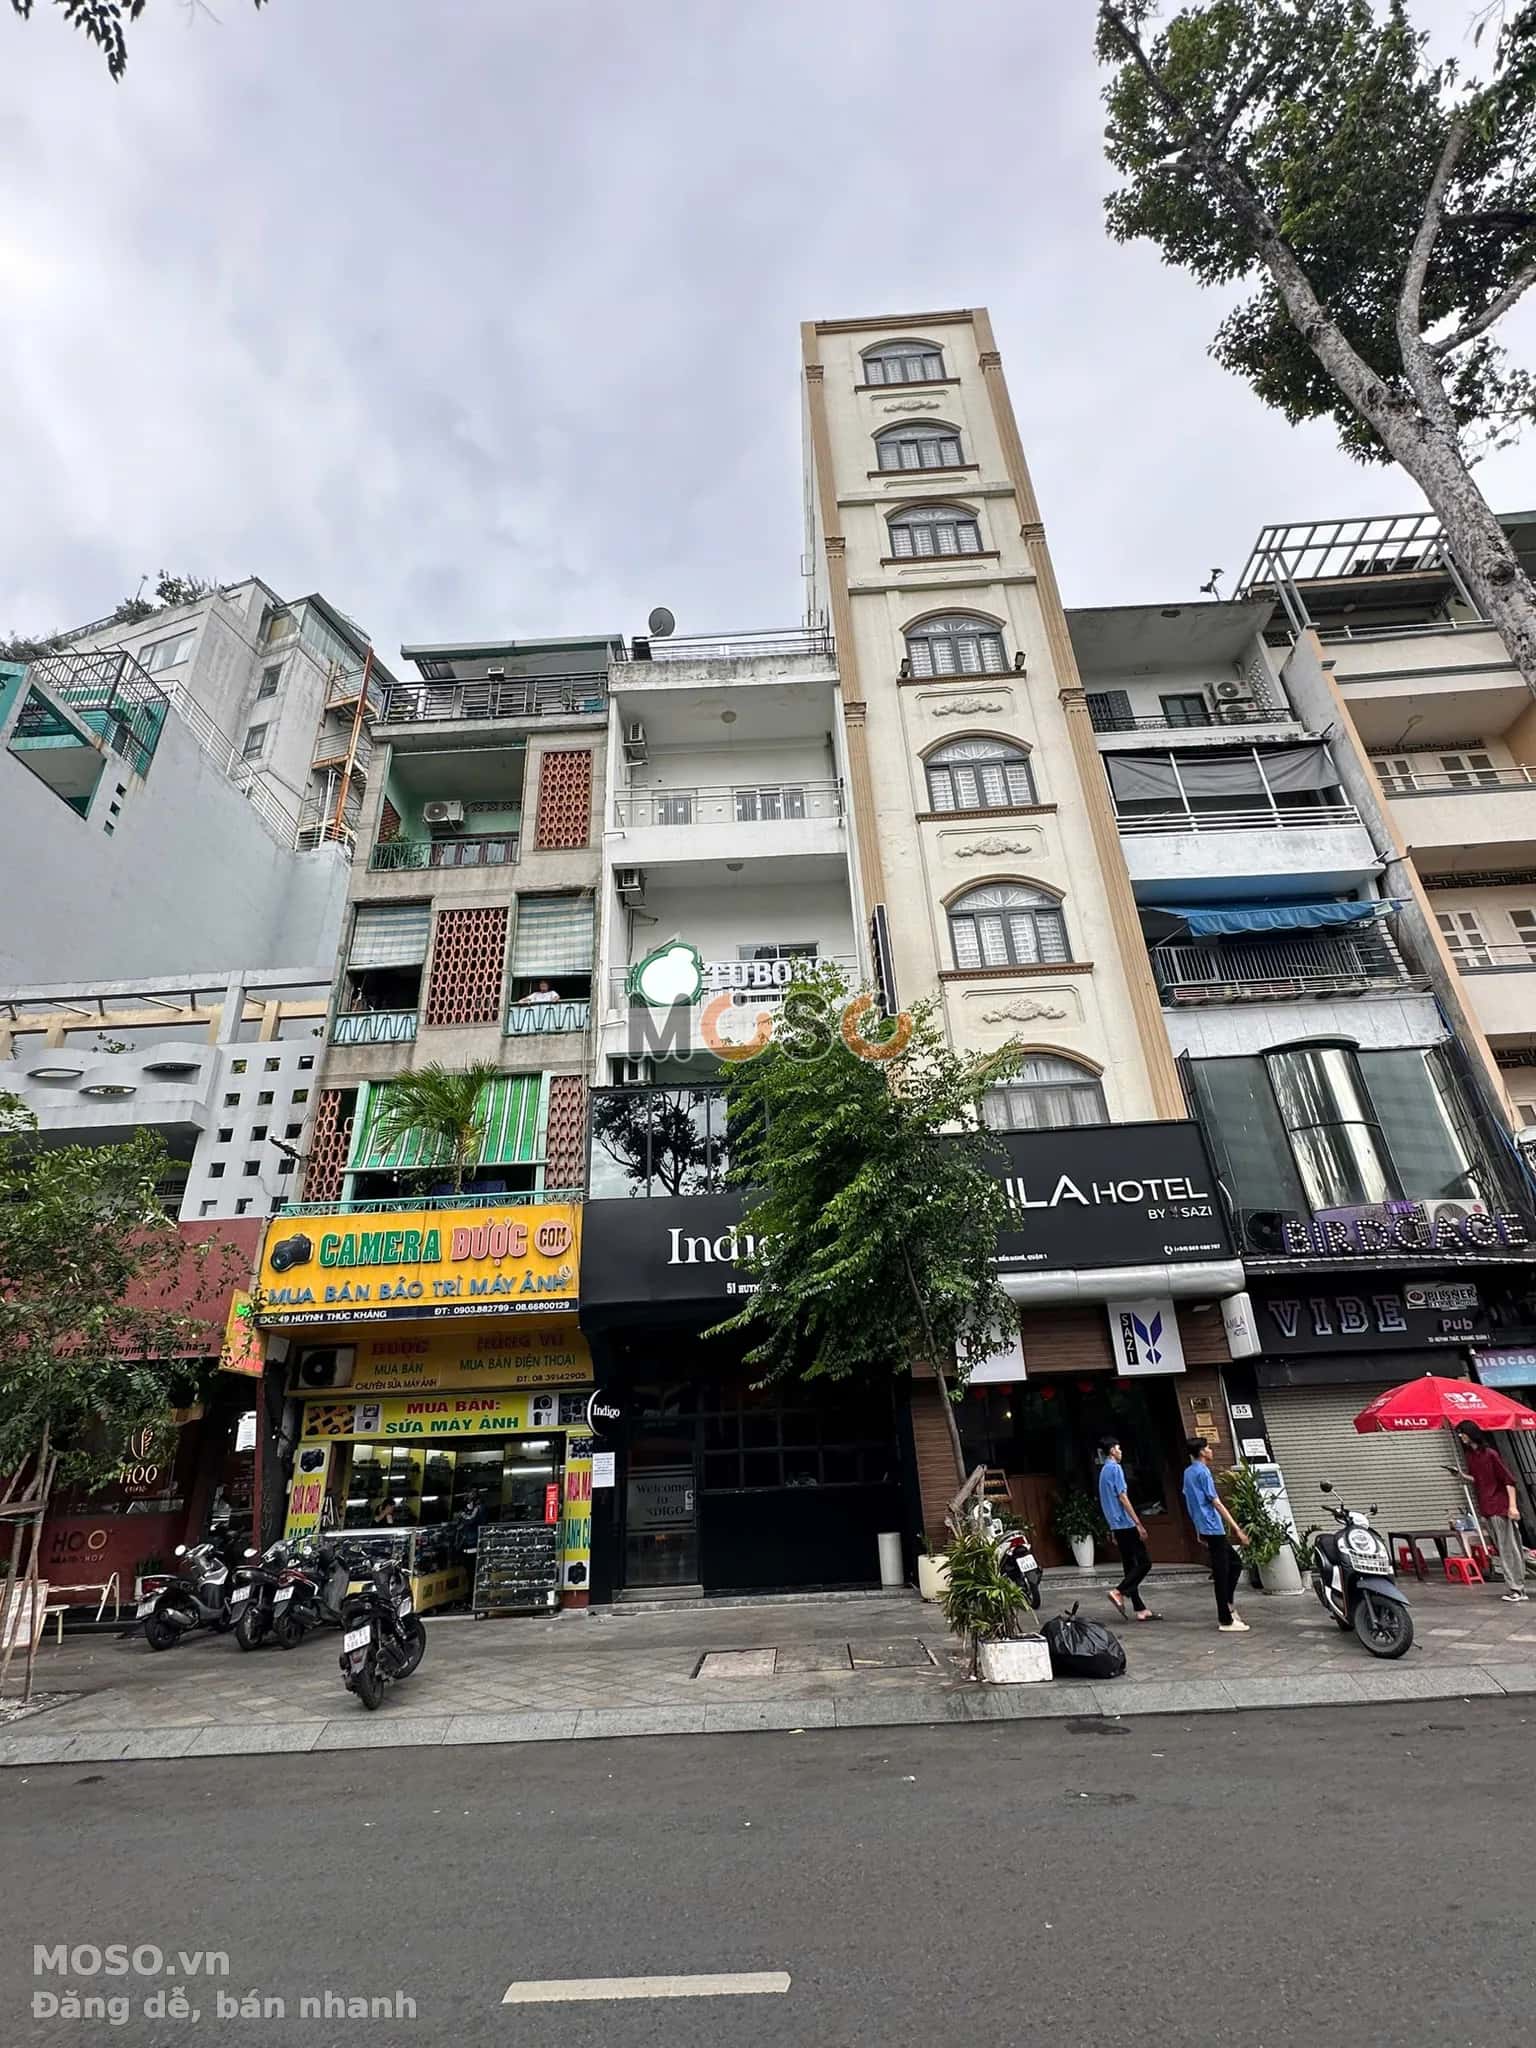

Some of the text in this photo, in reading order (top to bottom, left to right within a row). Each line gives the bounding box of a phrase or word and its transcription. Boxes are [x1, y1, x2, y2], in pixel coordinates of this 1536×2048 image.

[1093, 1177, 1208, 1205] HOTEL
[1148, 1206, 1213, 1220] BY SAZI
[318, 1217, 567, 1268] CAMERA ĐƯỢC COM
[1284, 1213, 1529, 1254] BIRDCAGE
[269, 1287, 315, 1306] MUA
[324, 1279, 370, 1302] BÁN
[379, 1276, 424, 1300] BẢO
[470, 1274, 516, 1294] MÁY
[520, 1268, 566, 1292] ẢNH
[1268, 1296, 1407, 1337] VIBE
[1442, 1318, 1473, 1332] Pub
[1120, 1313, 1138, 1365] SAZI
[459, 1358, 484, 1372] MUA
[1475, 1355, 1536, 1368] BIRDCAG
[406, 1400, 448, 1414] MUA
[593, 1404, 620, 1418] Indigo
[430, 1414, 472, 1432] MÁY
[478, 1411, 519, 1430] ẢNH
